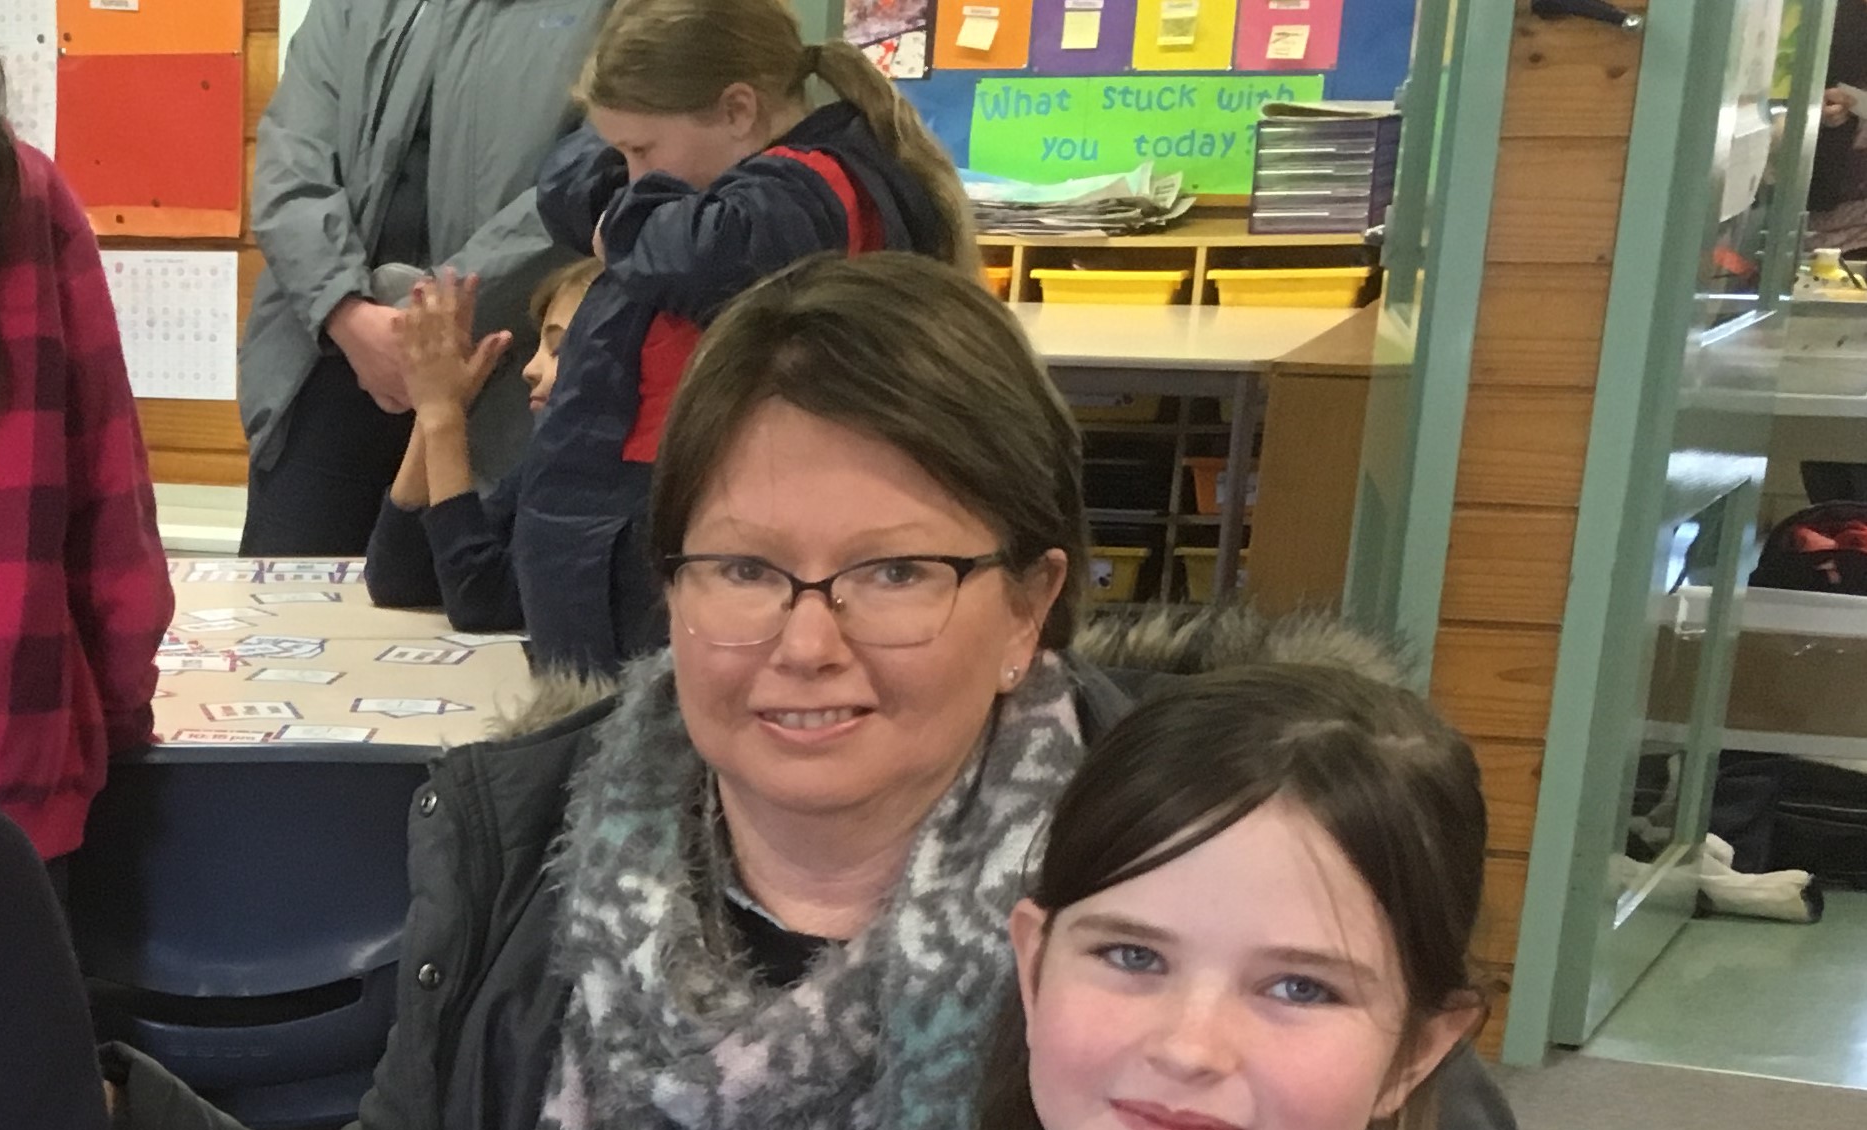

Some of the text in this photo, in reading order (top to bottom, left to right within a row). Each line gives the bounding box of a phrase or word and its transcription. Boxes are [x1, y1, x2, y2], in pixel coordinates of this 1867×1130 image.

[978, 85, 1072, 121] What
[1102, 83, 1197, 112] stuck
[1041, 135, 1099, 162] you
